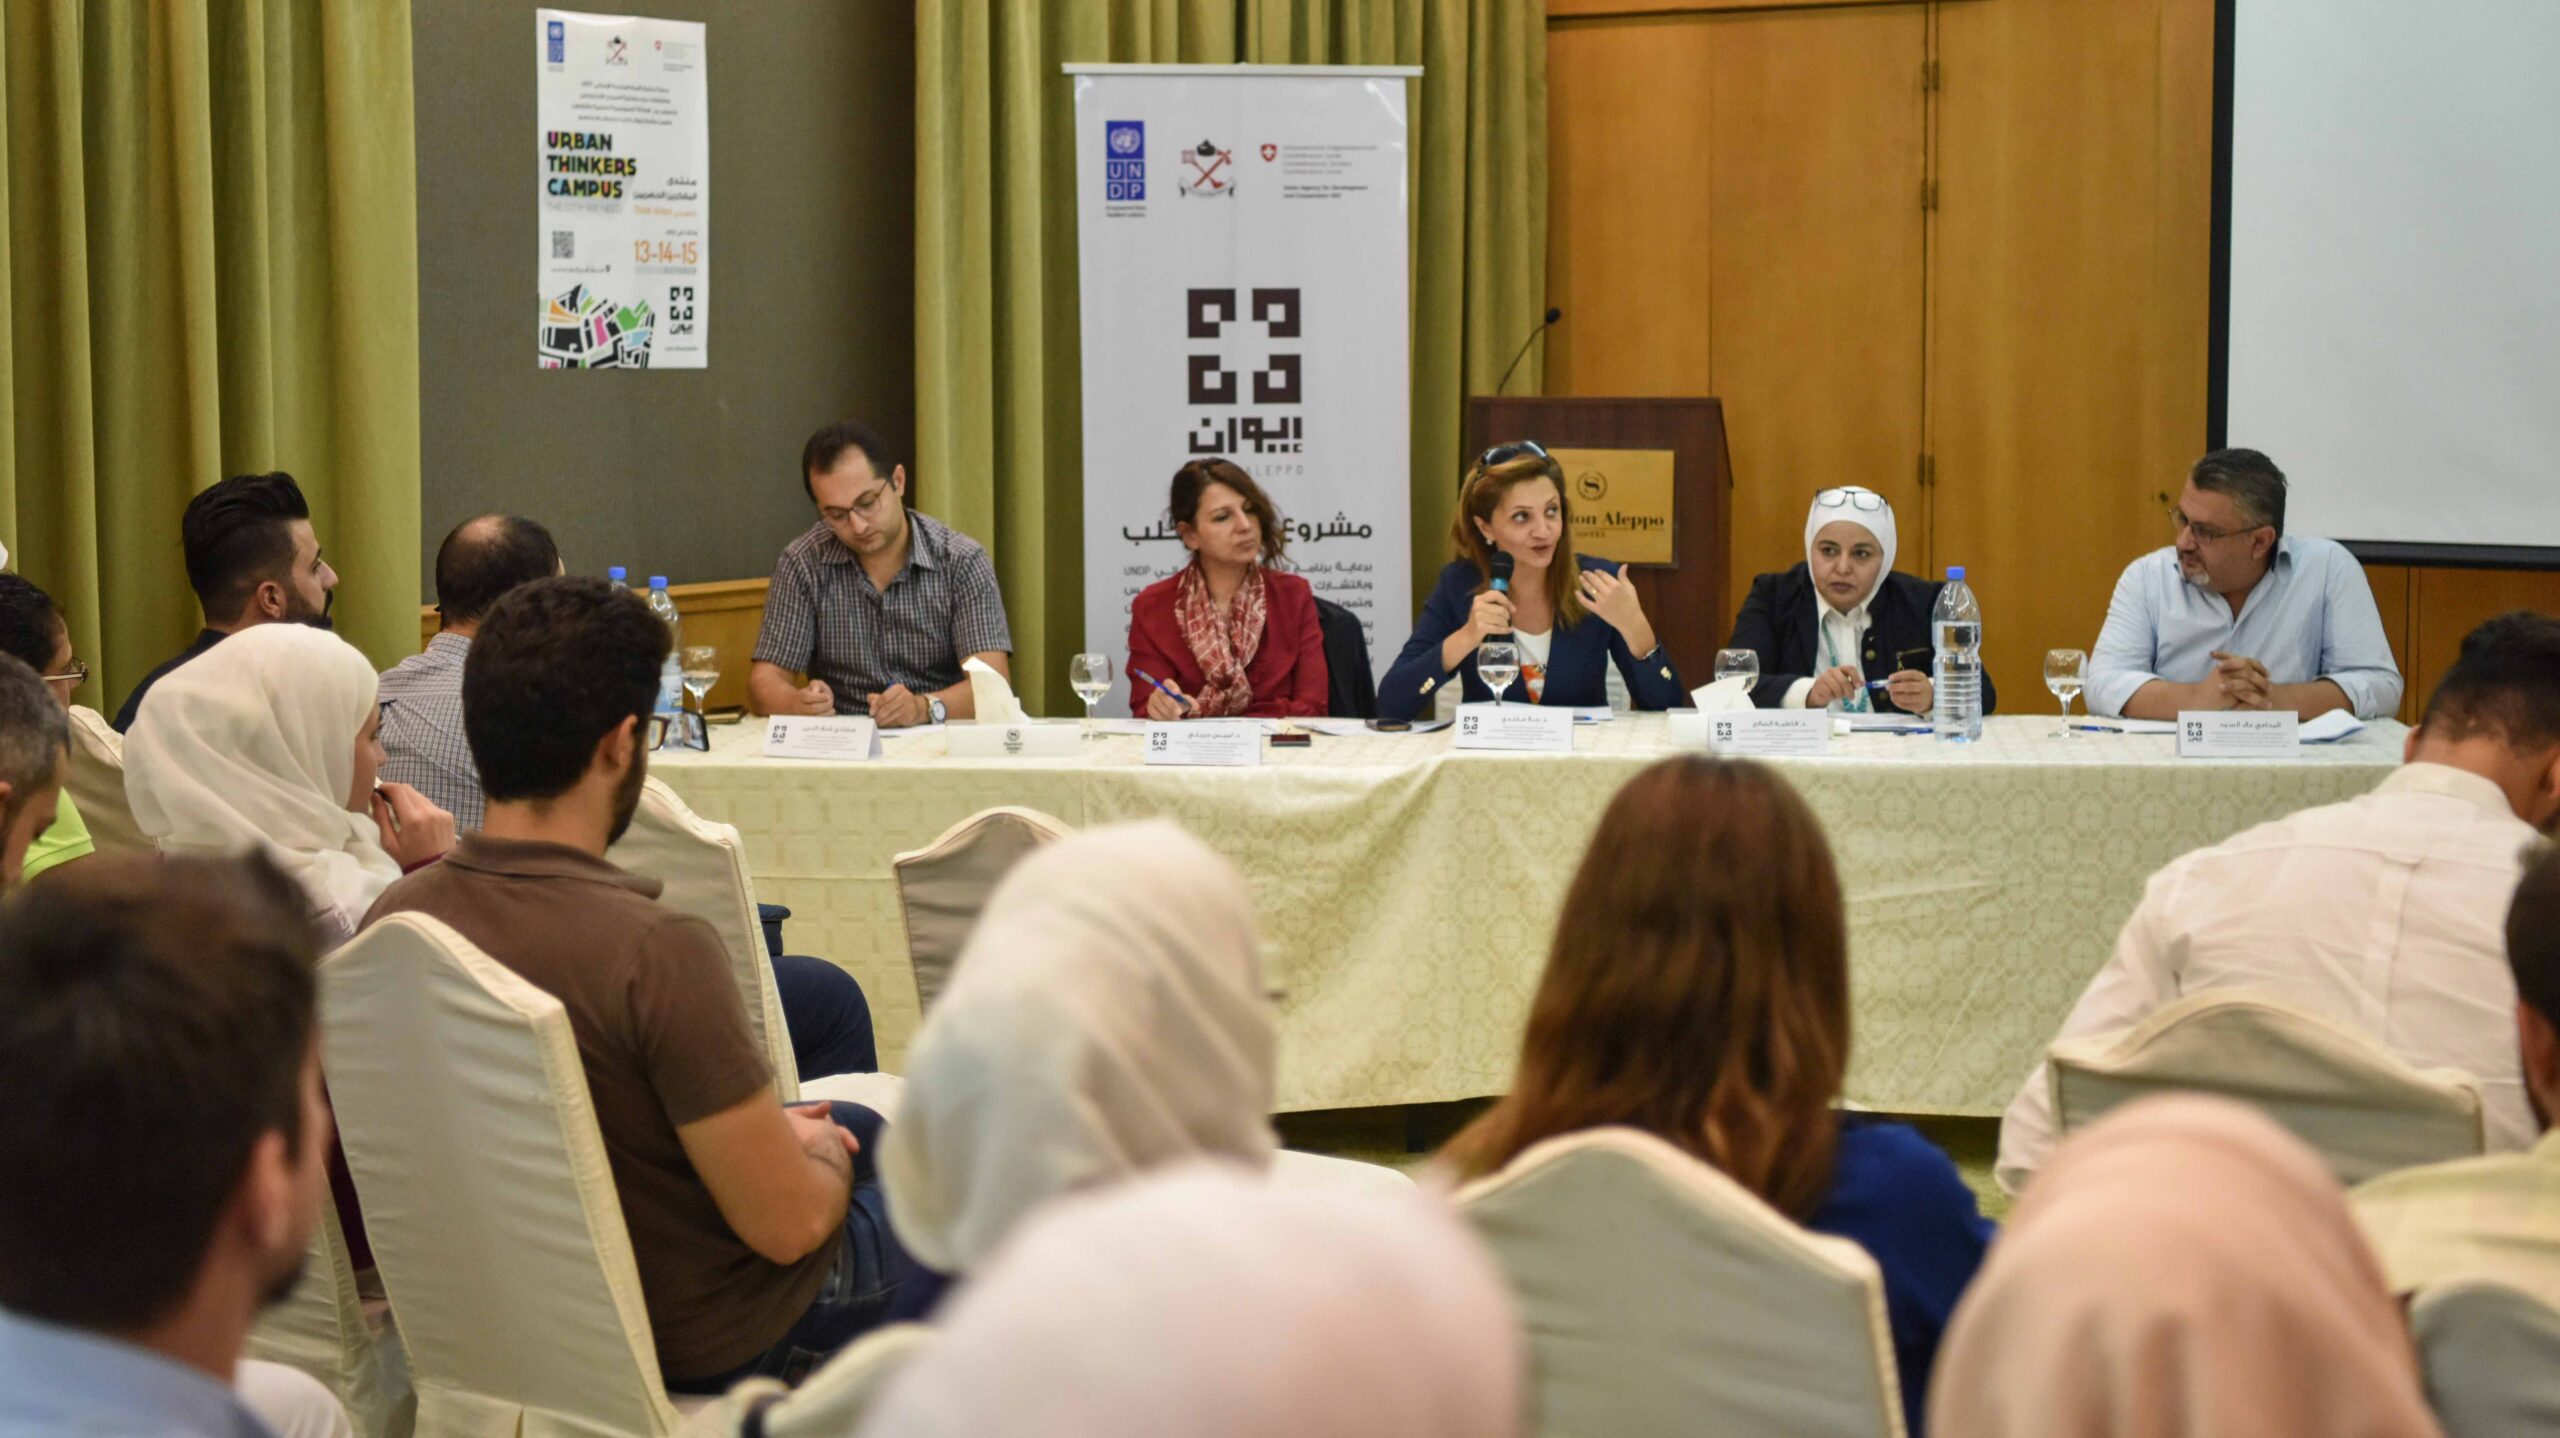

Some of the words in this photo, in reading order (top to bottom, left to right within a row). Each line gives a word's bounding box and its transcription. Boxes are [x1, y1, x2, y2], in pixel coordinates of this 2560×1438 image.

[547, 130, 612, 150] URBAN
[547, 154, 637, 176] THINKERS
[547, 178, 622, 198] CAMPUS
[634, 239, 698, 264] 13-14-15
[1189, 416, 1303, 454] إيوان
[1605, 511, 1664, 531] Aleppo
[1123, 519, 1182, 546] لب
[1123, 565, 1151, 576] UNDP
